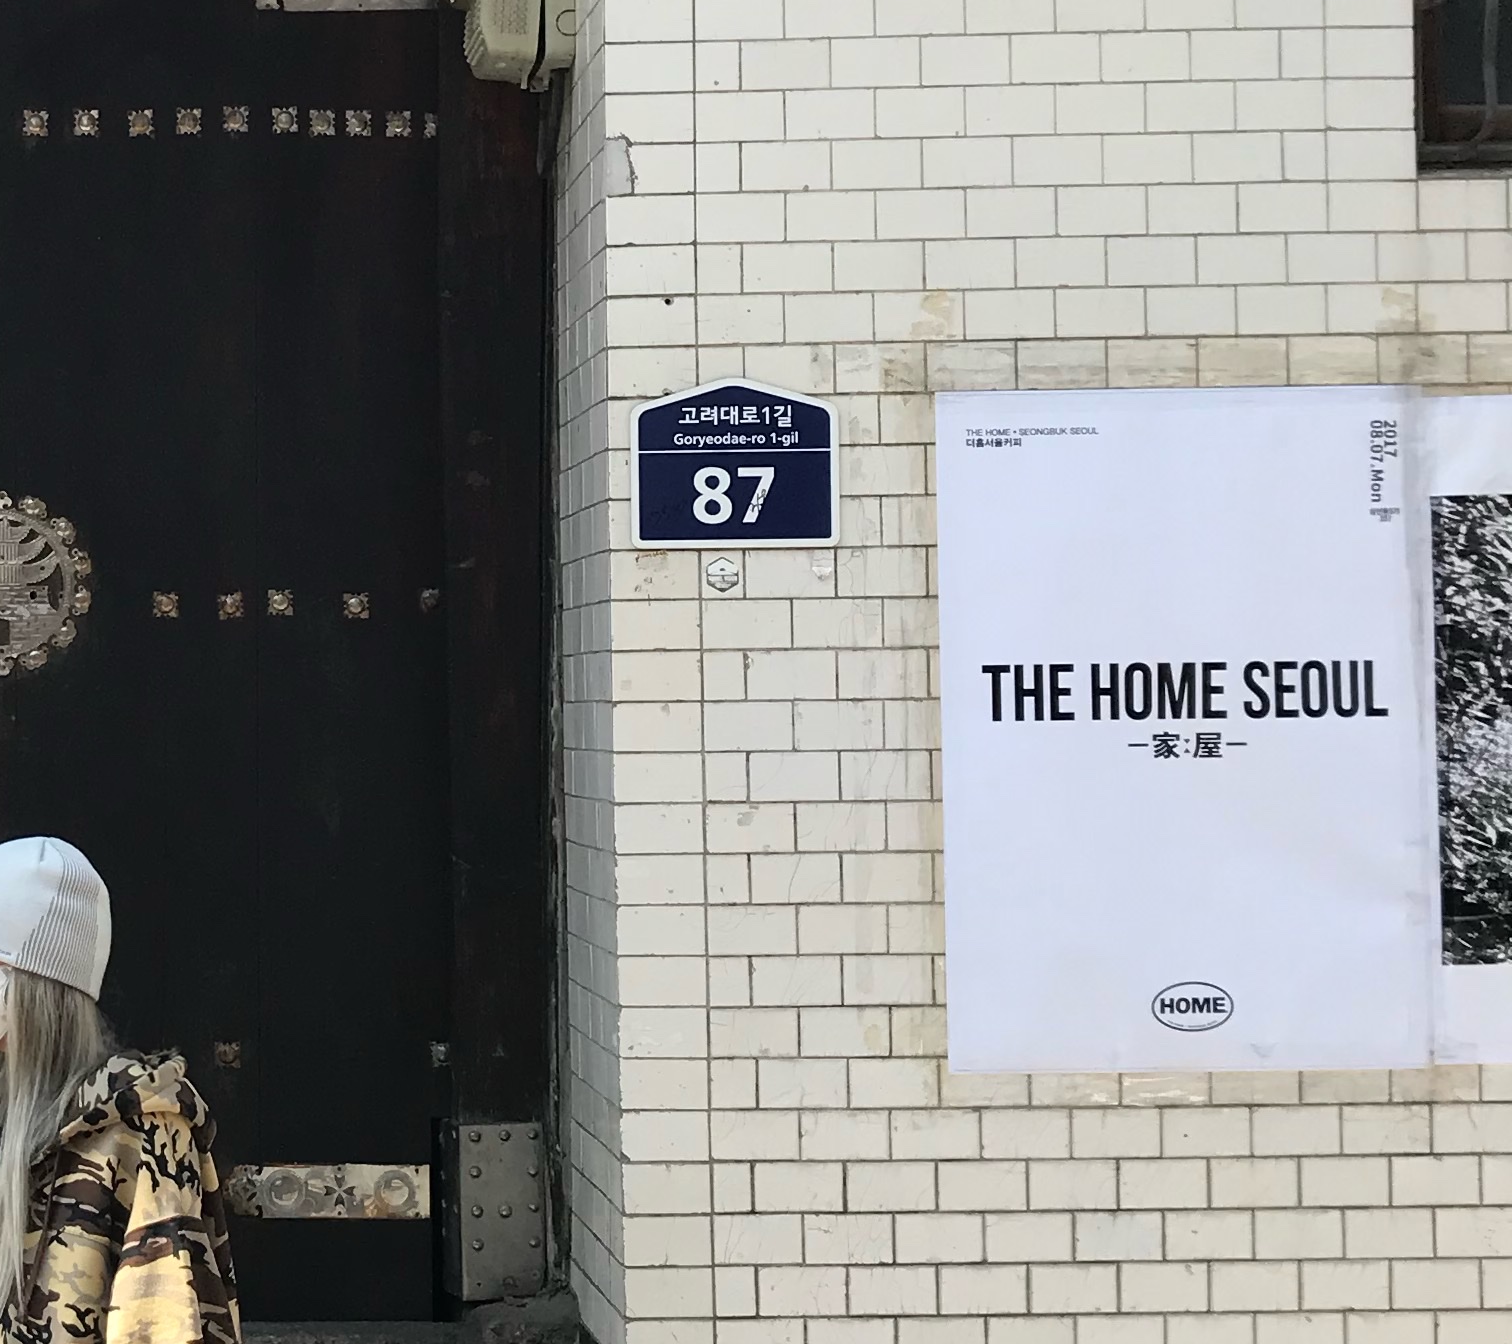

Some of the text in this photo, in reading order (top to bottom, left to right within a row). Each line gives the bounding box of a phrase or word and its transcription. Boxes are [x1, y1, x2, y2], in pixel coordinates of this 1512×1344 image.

[678, 405, 792, 427] 고려대로1길
[673, 431, 799, 447] Goryeodae-ro 1-gil
[966, 426, 1099, 436] THE HOME SEONGBUK SEOUL
[1383, 420, 1397, 457] 2017
[1370, 420, 1384, 502] 08.07.Mon
[692, 466, 775, 525] 87
[982, 659, 1389, 721] THE HOME SEOUL
[1160, 997, 1228, 1014] HOME
